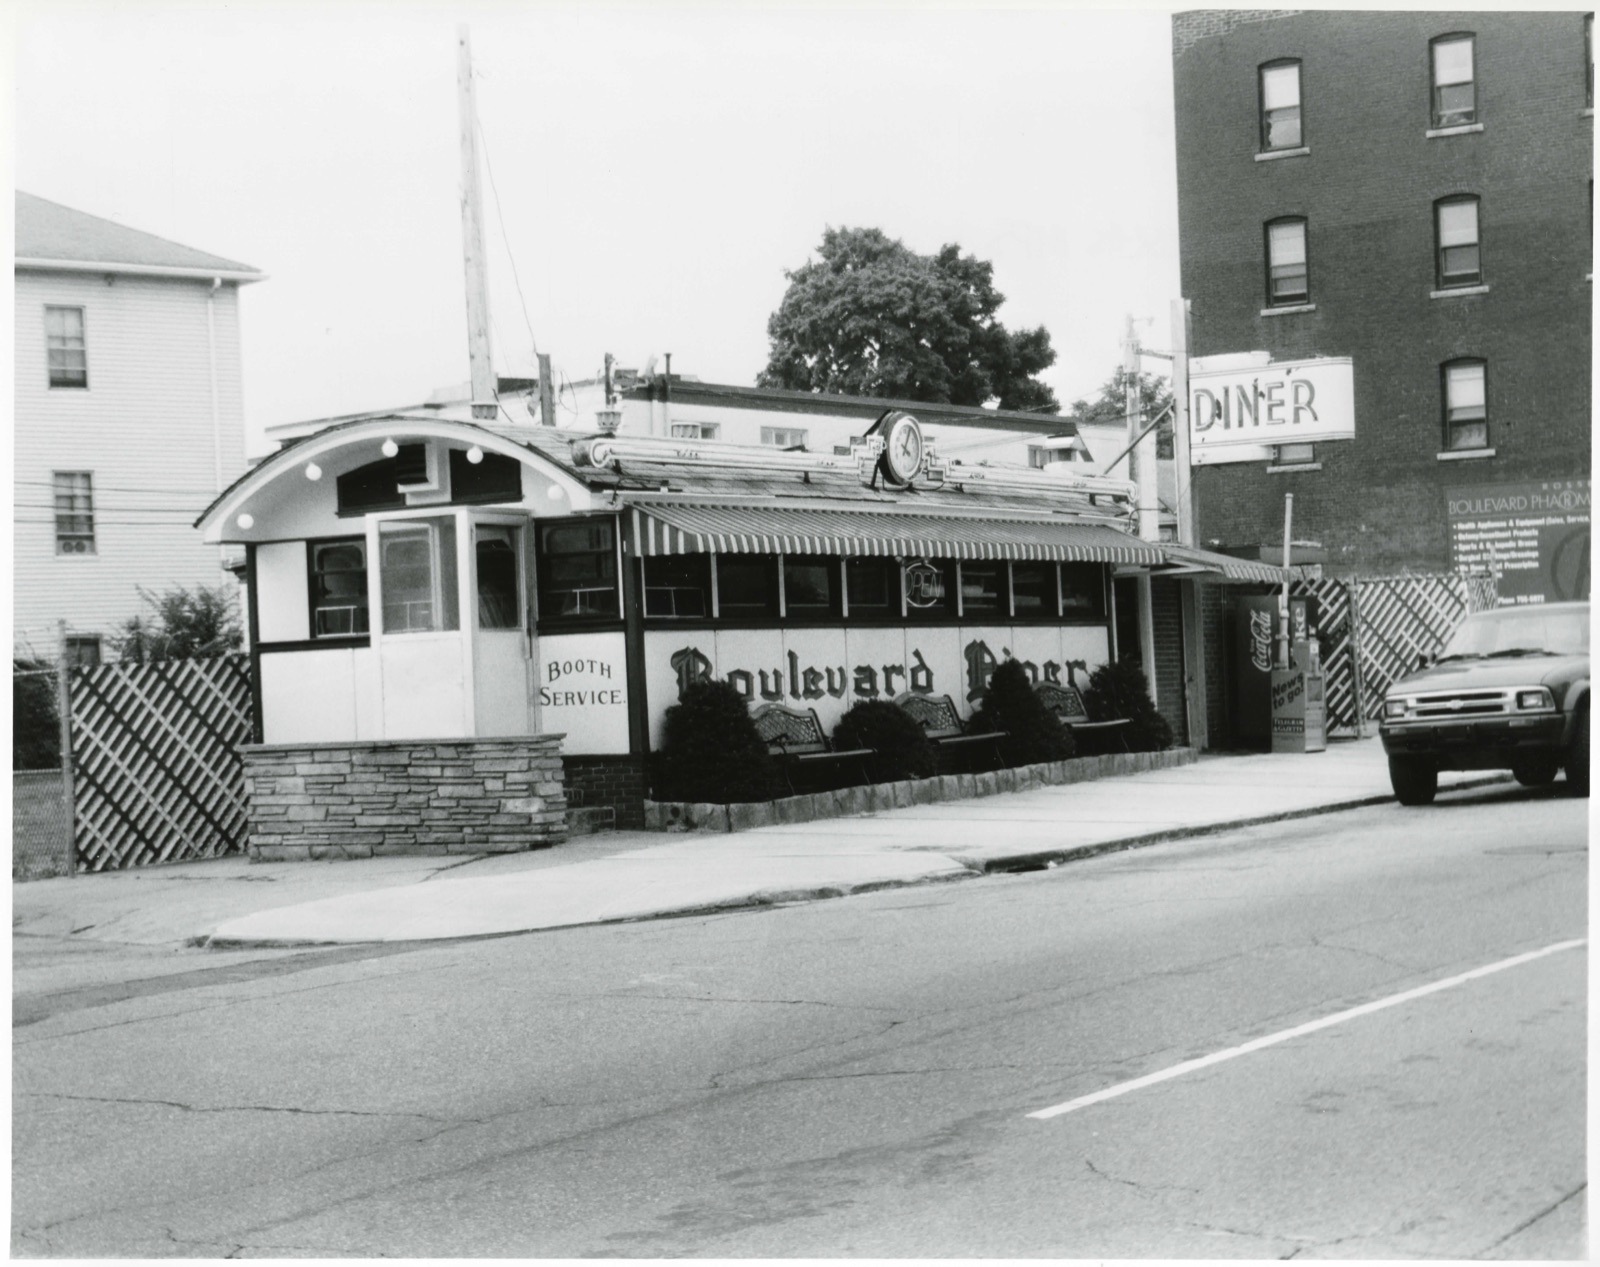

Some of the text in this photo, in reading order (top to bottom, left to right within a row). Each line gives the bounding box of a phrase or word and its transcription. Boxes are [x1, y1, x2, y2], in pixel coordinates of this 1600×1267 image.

[1194, 379, 1318, 433] DINER
[1449, 496, 1528, 515] BOULEVARD
[905, 570, 942, 598] OPEN
[547, 659, 612, 682] BOOTH
[671, 646, 935, 704] Boulevard
[1272, 672, 1303, 698] News
[1273, 681, 1304, 710] to go!
